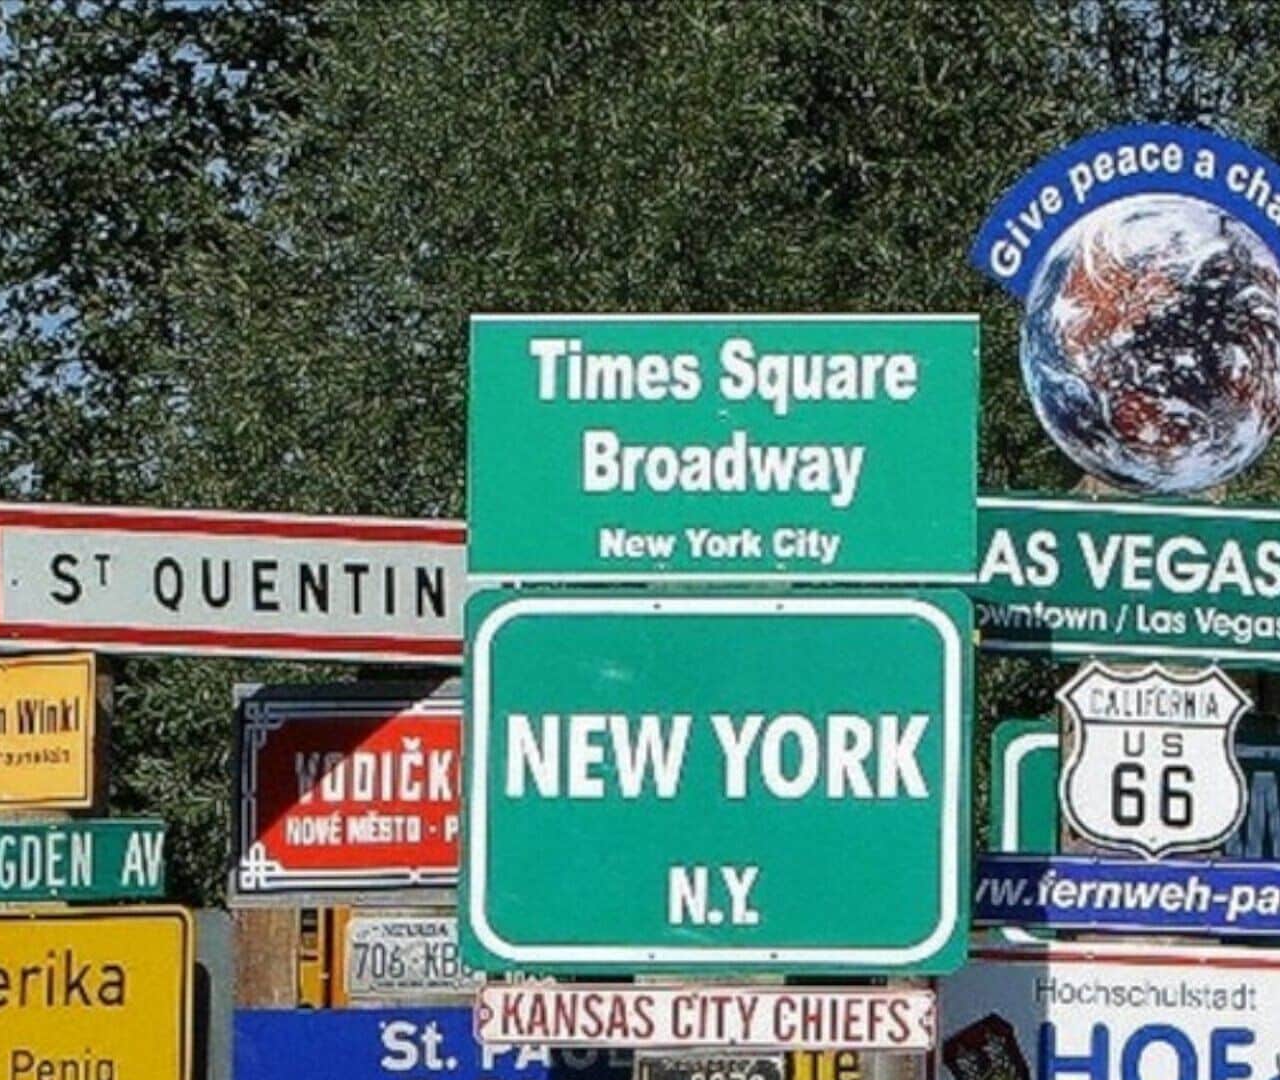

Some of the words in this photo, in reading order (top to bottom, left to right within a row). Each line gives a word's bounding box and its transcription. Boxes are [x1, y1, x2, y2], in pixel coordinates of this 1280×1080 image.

[990, 185, 1062, 277] Give
[1068, 142, 1182, 203] peace
[1194, 148, 1215, 179] a
[529, 337, 702, 401] Times
[719, 337, 919, 416] Square
[582, 428, 865, 506] Broadway
[599, 528, 675, 558] New
[685, 528, 763, 558] York
[773, 528, 840, 564] City
[51, 553, 110, 605] St
[154, 557, 446, 618] QUENTIN
[1136, 606, 1186, 635] Las
[20, 698, 81, 733] Winkl
[1089, 688, 1220, 719] CALIFORNIA
[504, 714, 692, 800] NEW
[710, 714, 929, 800] YORK
[1111, 764, 1194, 827] 66
[122, 830, 164, 887] AV
[667, 866, 760, 926] N.Y.
[502, 992, 655, 1043] KANSAS
[671, 991, 755, 1041] CITY
[773, 995, 911, 1042] CHIEFS
[1035, 976, 1258, 1012] Hochschulstadt
[381, 1020, 458, 1071] St.
